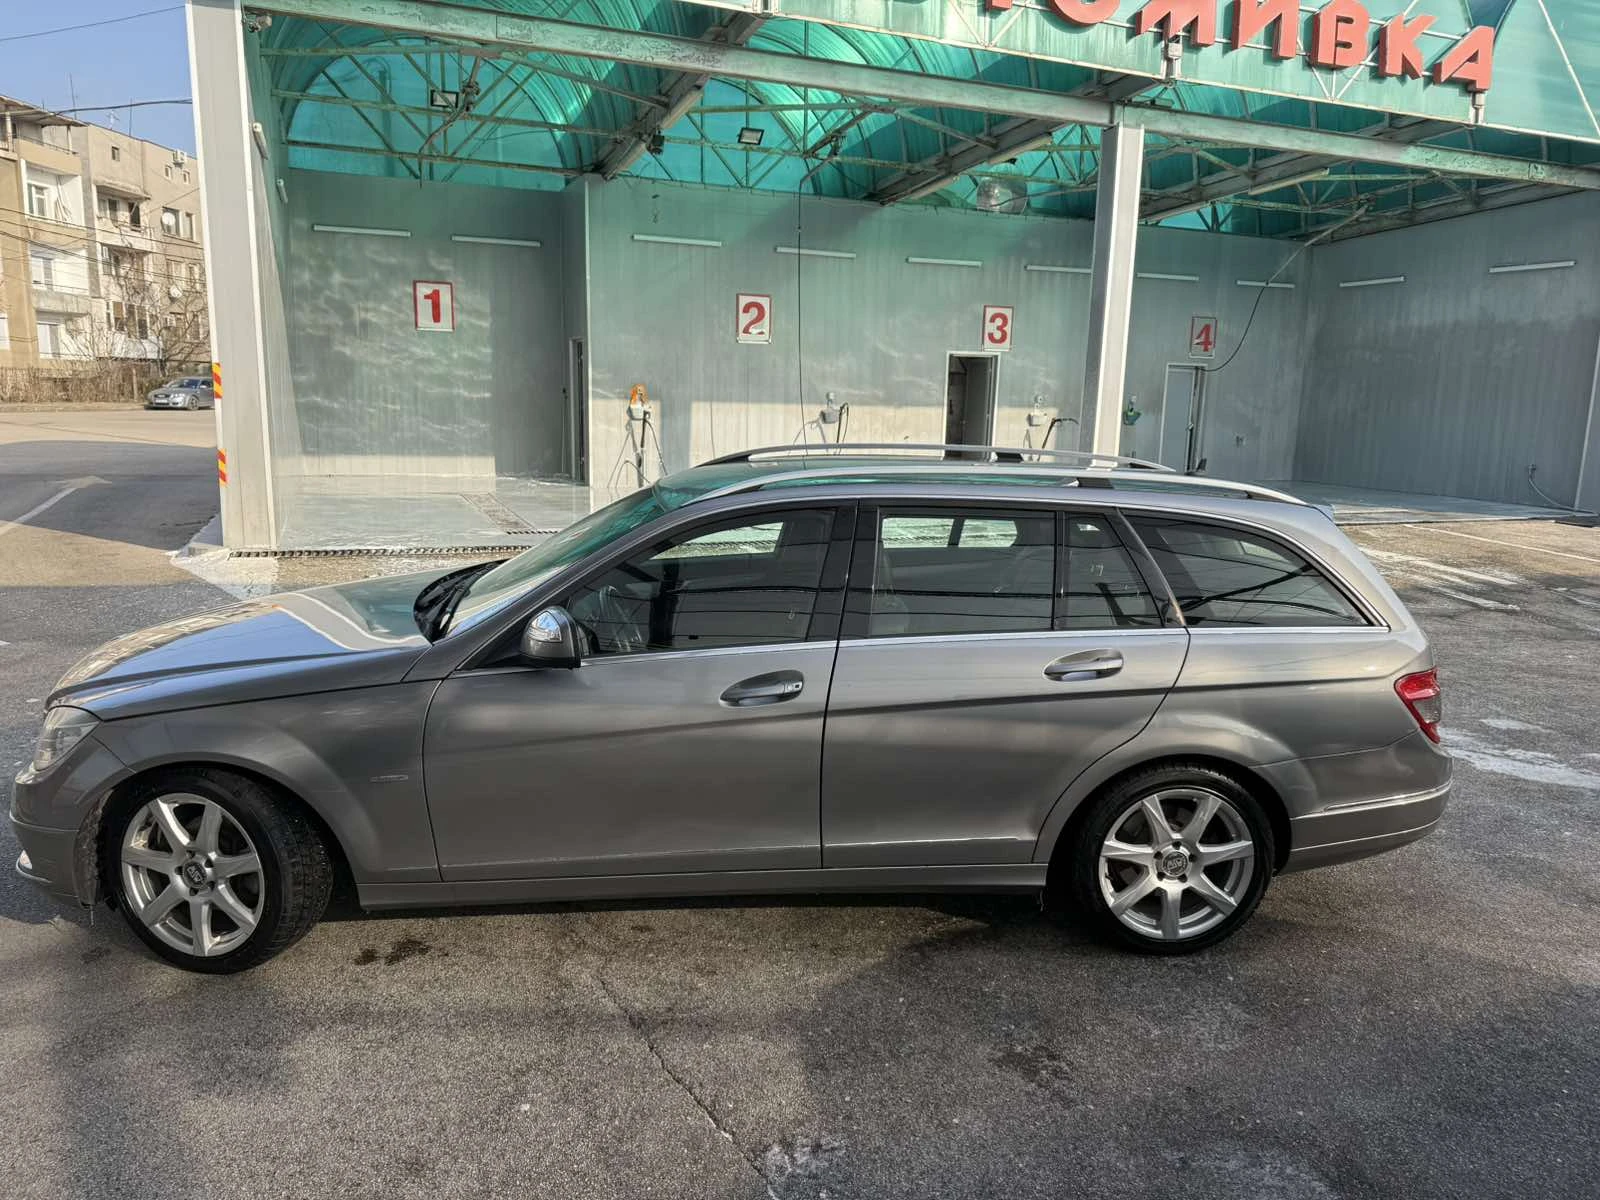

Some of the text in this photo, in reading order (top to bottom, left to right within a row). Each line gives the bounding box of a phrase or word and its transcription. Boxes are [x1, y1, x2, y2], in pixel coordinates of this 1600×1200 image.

[985, 0, 1495, 92] МИВКА
[424, 289, 441, 323] 1
[743, 301, 765, 335] 2
[988, 312, 1009, 344] 3
[1194, 324, 1212, 352] 4
